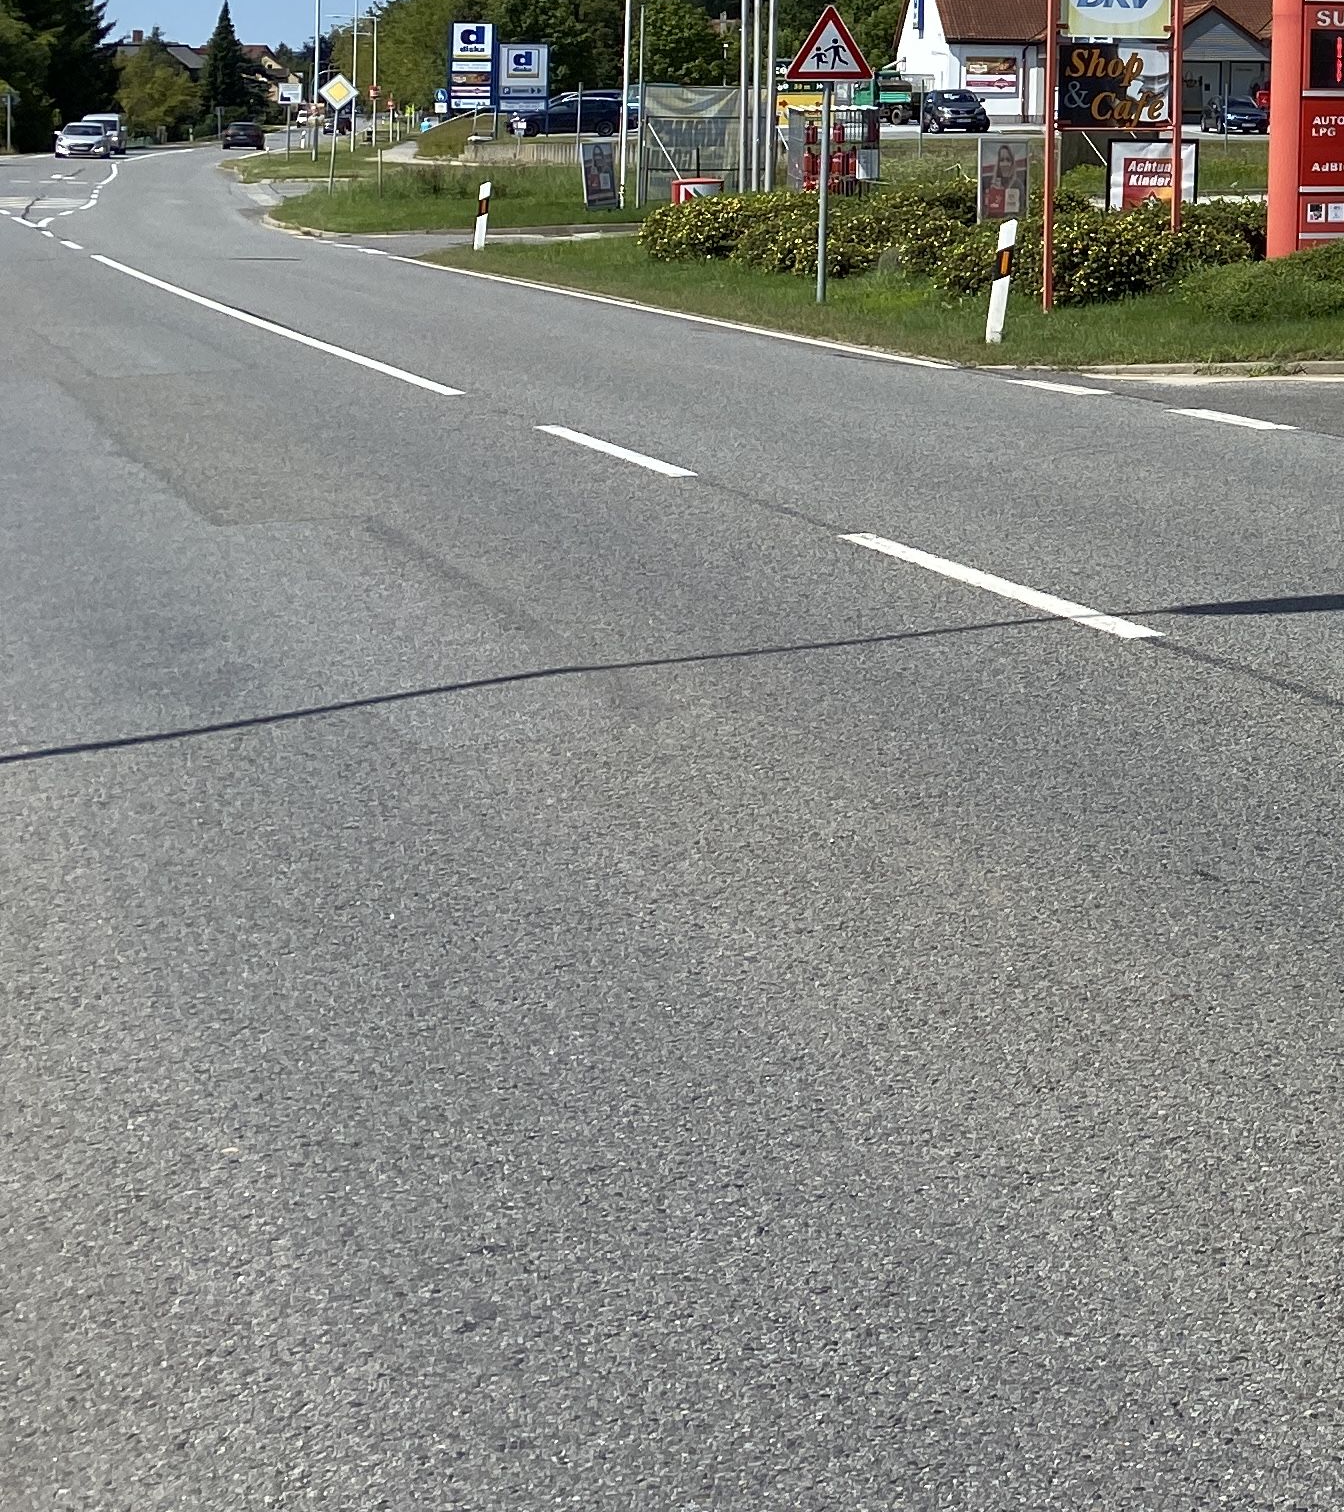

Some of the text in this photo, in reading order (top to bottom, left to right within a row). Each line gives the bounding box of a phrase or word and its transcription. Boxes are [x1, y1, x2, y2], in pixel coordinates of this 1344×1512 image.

[1065, 48, 1144, 87] Shop
[1064, 81, 1165, 128] & Café
[1311, 127, 1336, 137] LPG
[1128, 160, 1172, 172] Achtun
